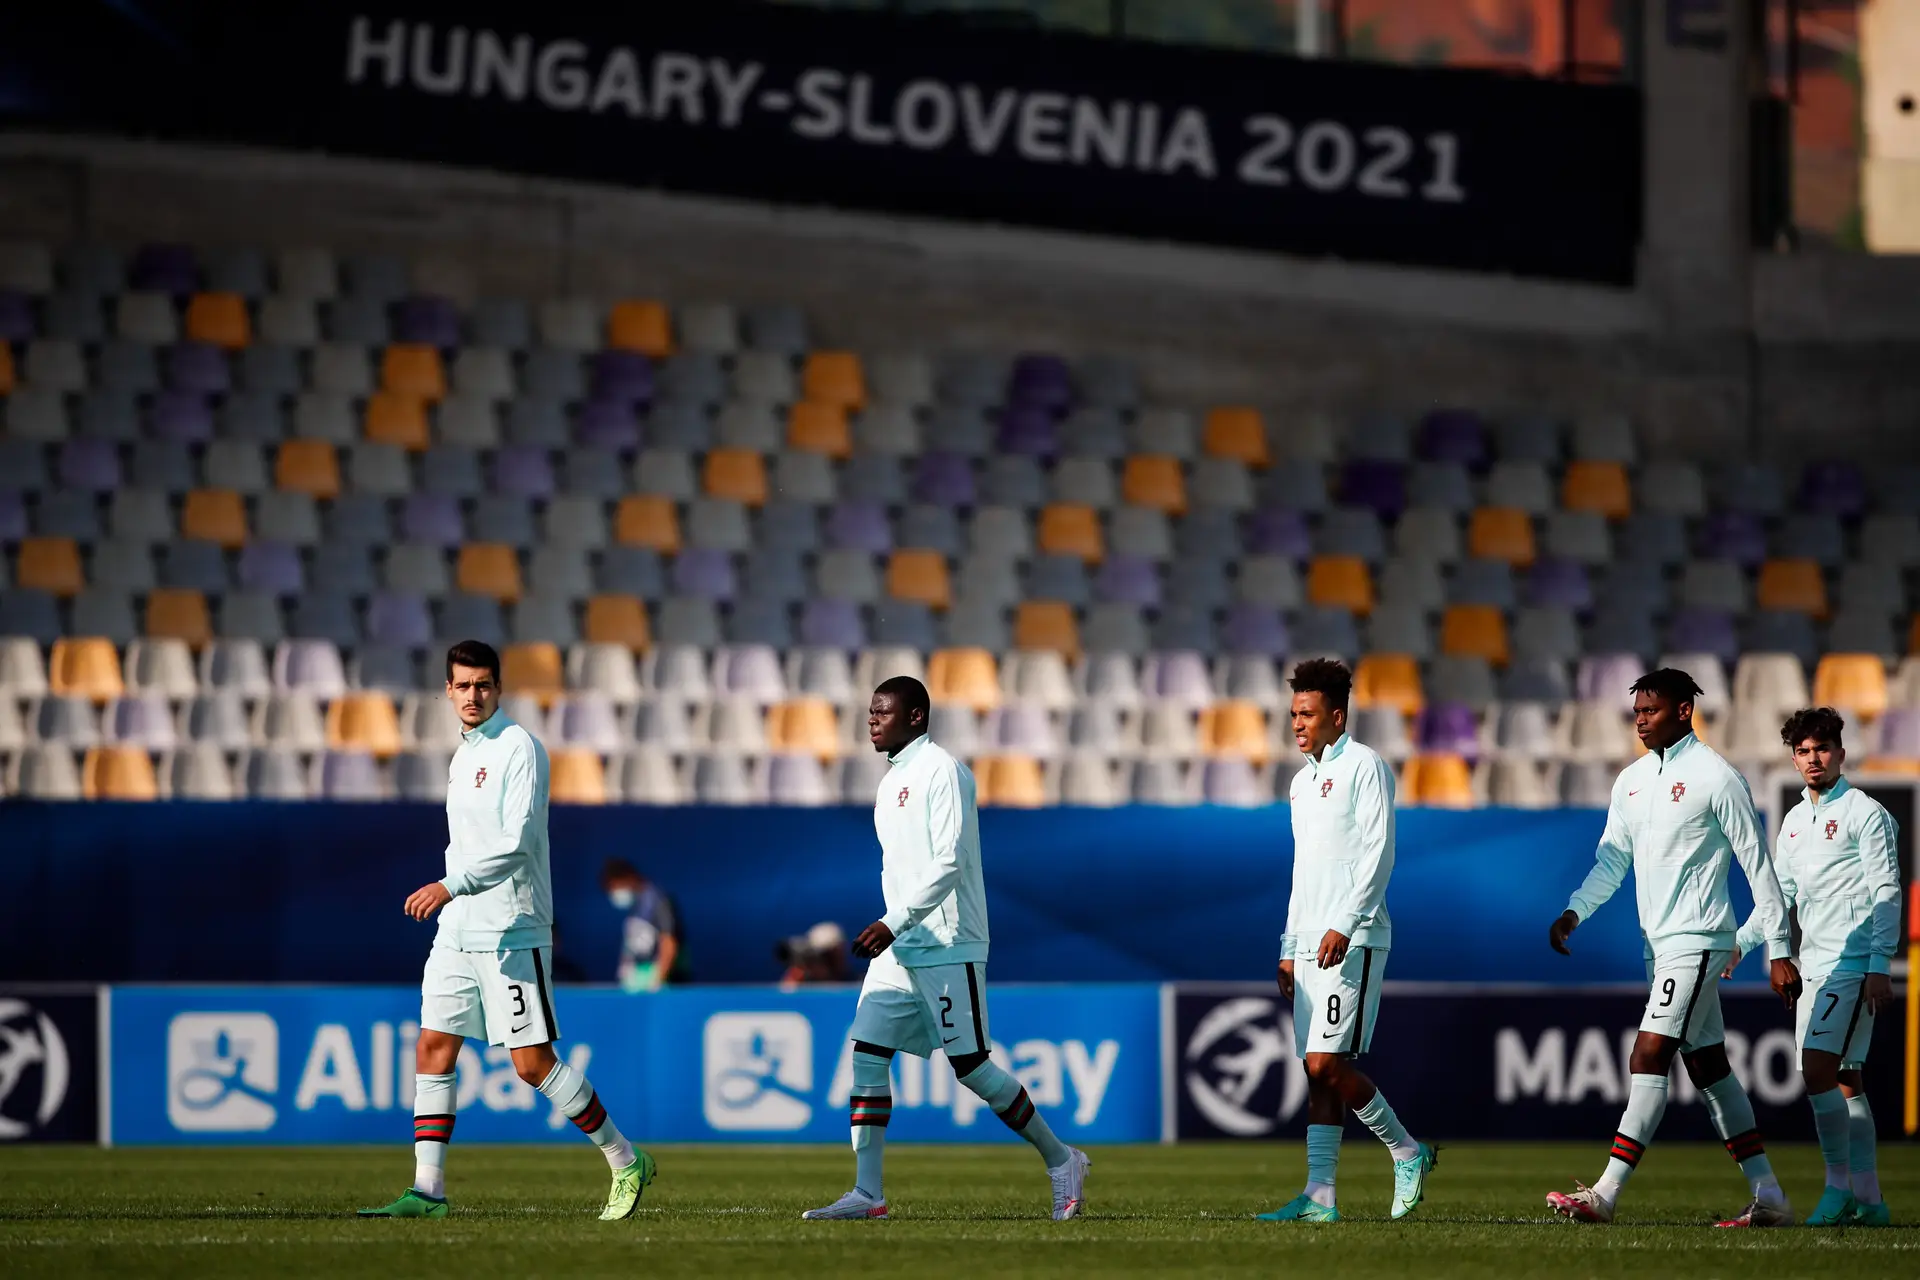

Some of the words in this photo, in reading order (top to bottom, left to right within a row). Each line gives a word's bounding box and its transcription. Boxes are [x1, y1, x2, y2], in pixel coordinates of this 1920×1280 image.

[348, 18, 1217, 179] HUNGARY-SLOVENIA
[1238, 116, 1464, 201] 2021
[508, 984, 526, 1017] 3
[1659, 978, 1676, 1007] 9
[1820, 992, 1840, 1022] 7
[938, 996, 955, 1029] 2
[1326, 994, 1341, 1026] 8
